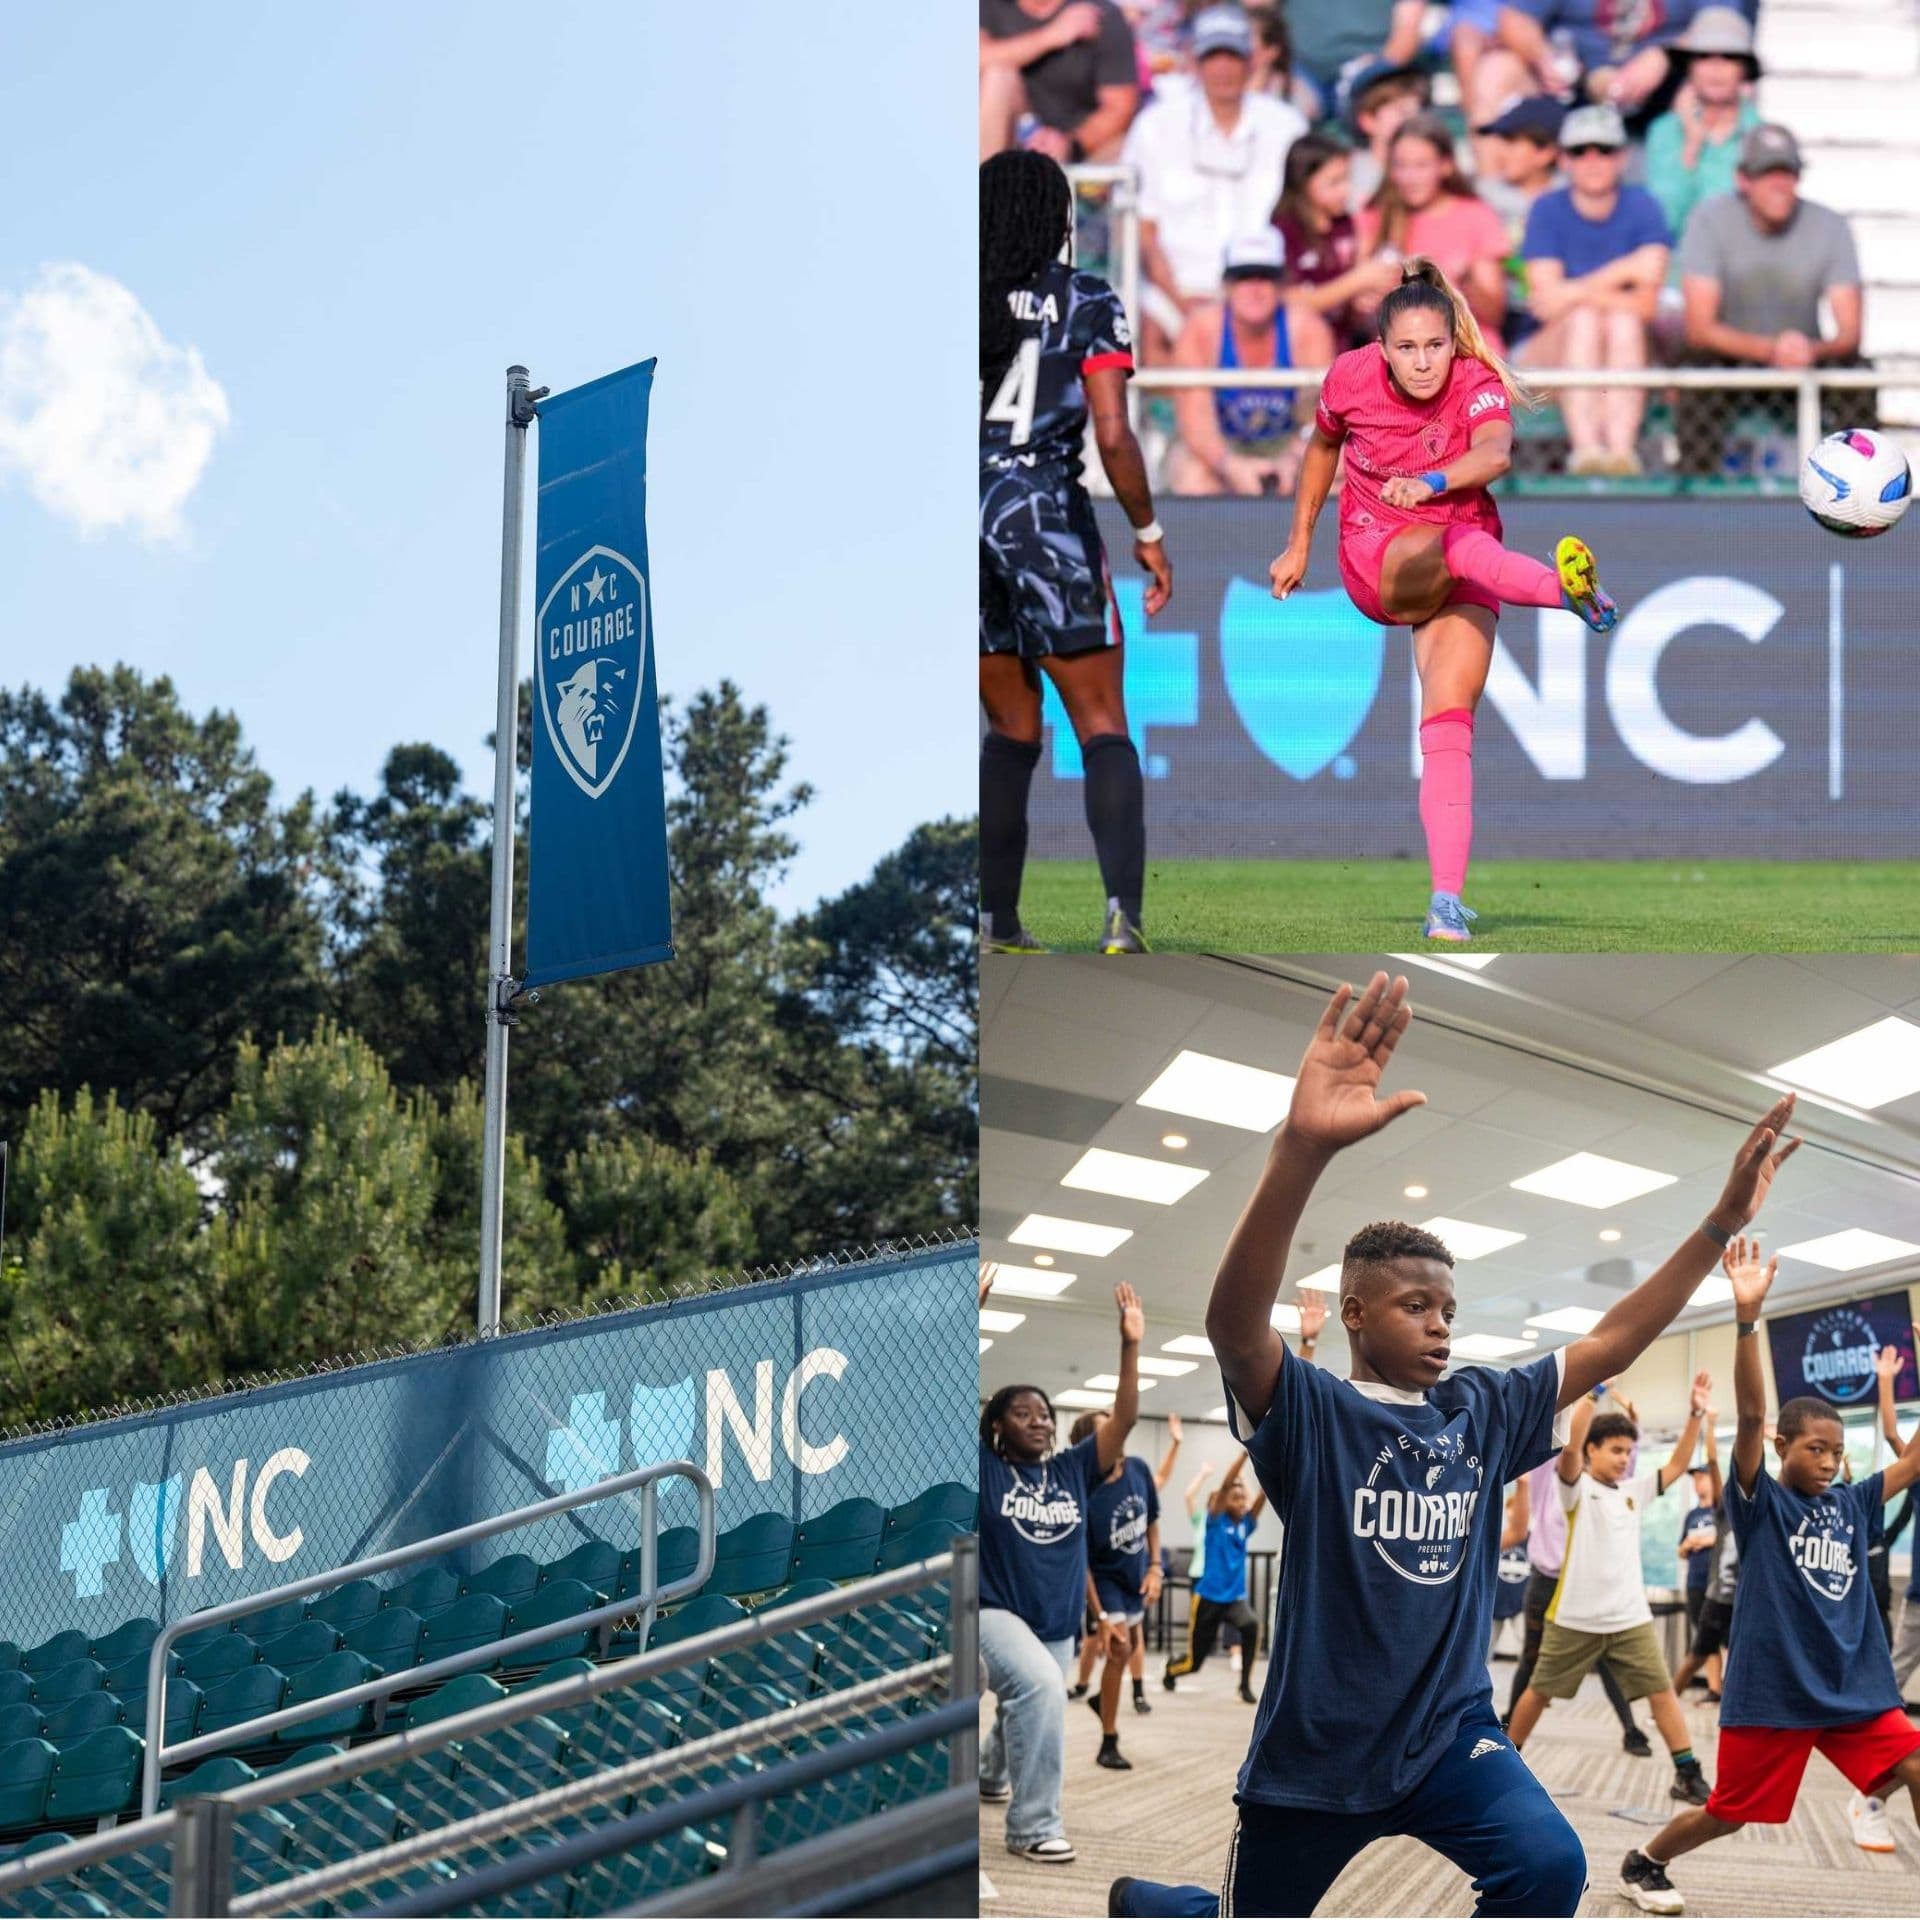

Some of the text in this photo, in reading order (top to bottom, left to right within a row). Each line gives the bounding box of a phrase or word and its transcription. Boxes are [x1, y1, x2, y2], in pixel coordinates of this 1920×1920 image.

[1469, 393, 1505, 417] ally
[550, 603, 634, 660] COURAGE
[1411, 577, 1785, 783] NC
[705, 1347, 850, 1490] NC
[187, 1447, 311, 1578] NC
